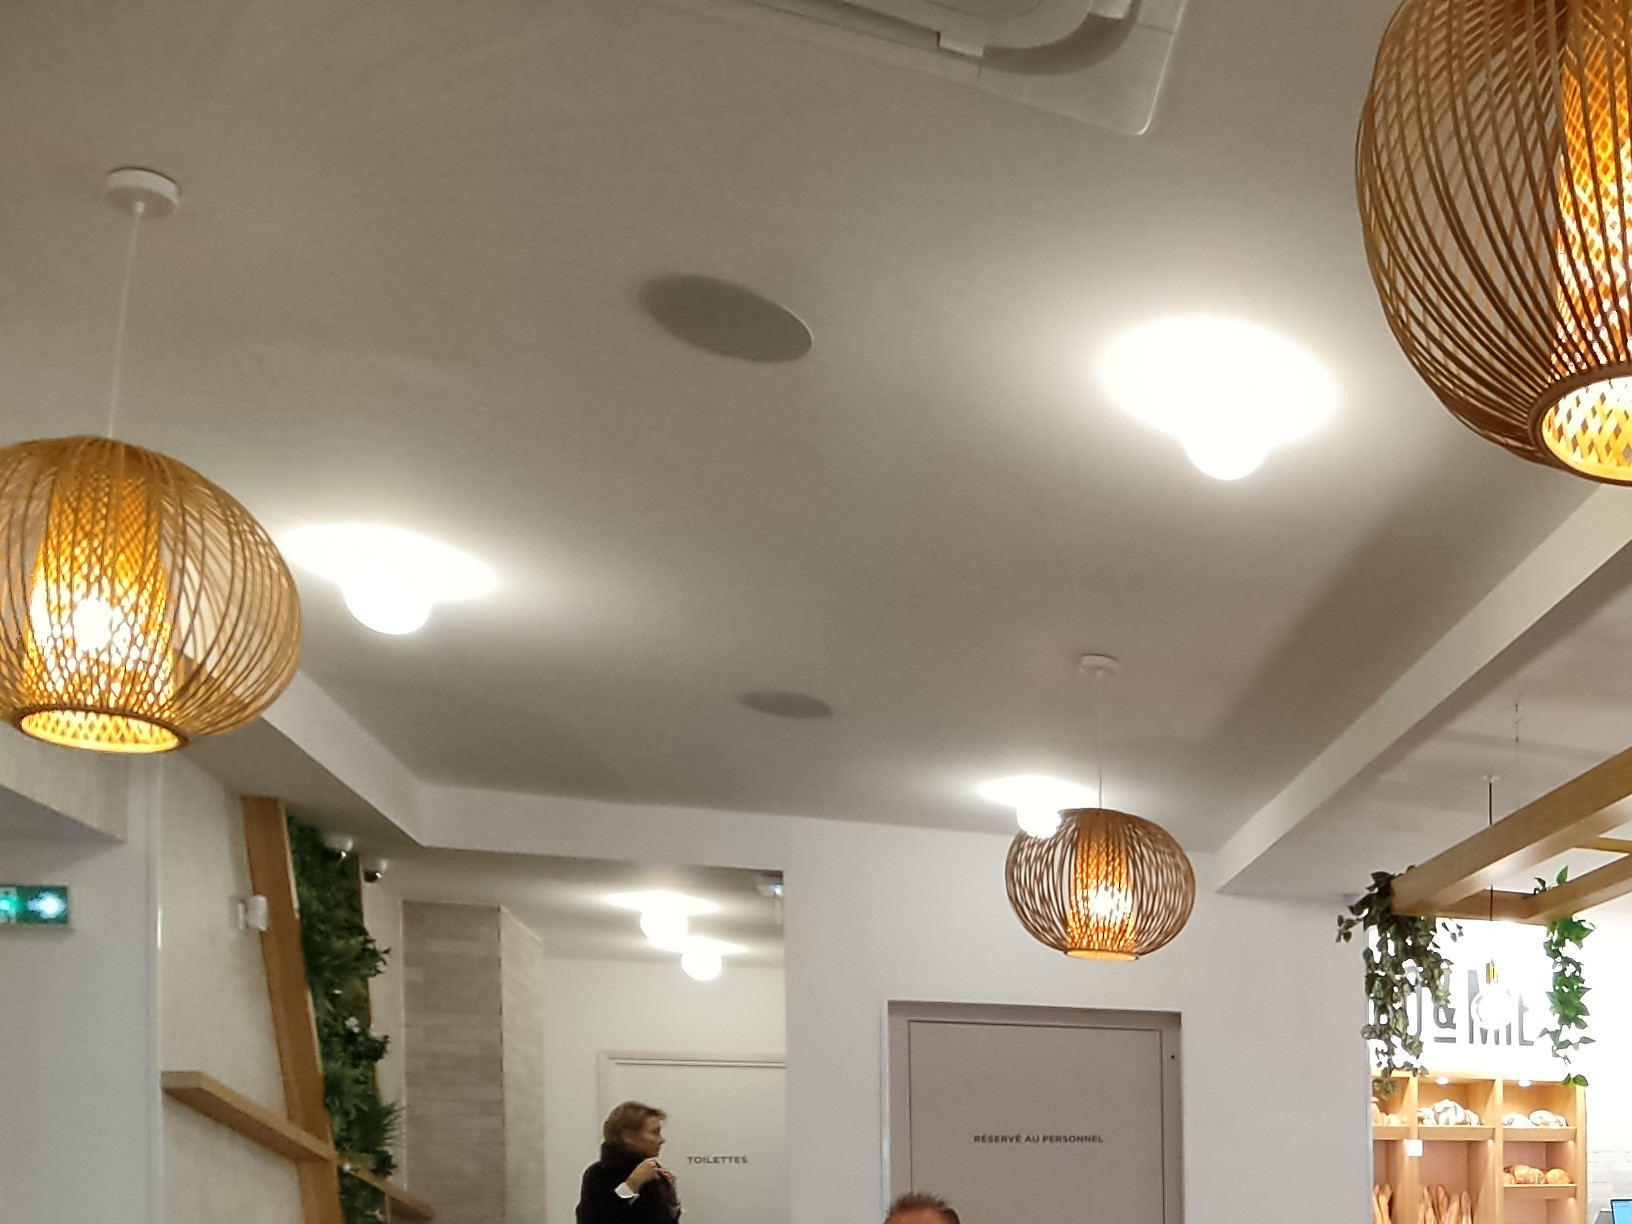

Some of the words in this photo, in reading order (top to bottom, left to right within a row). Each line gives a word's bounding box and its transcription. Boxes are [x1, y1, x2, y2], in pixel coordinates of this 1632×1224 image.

[973, 1133, 1021, 1143] RÉSERVÉ
[1025, 1134, 1040, 1143] AU
[1042, 1134, 1104, 1143] PERSONNEL
[687, 1156, 748, 1164] TOILETTES
